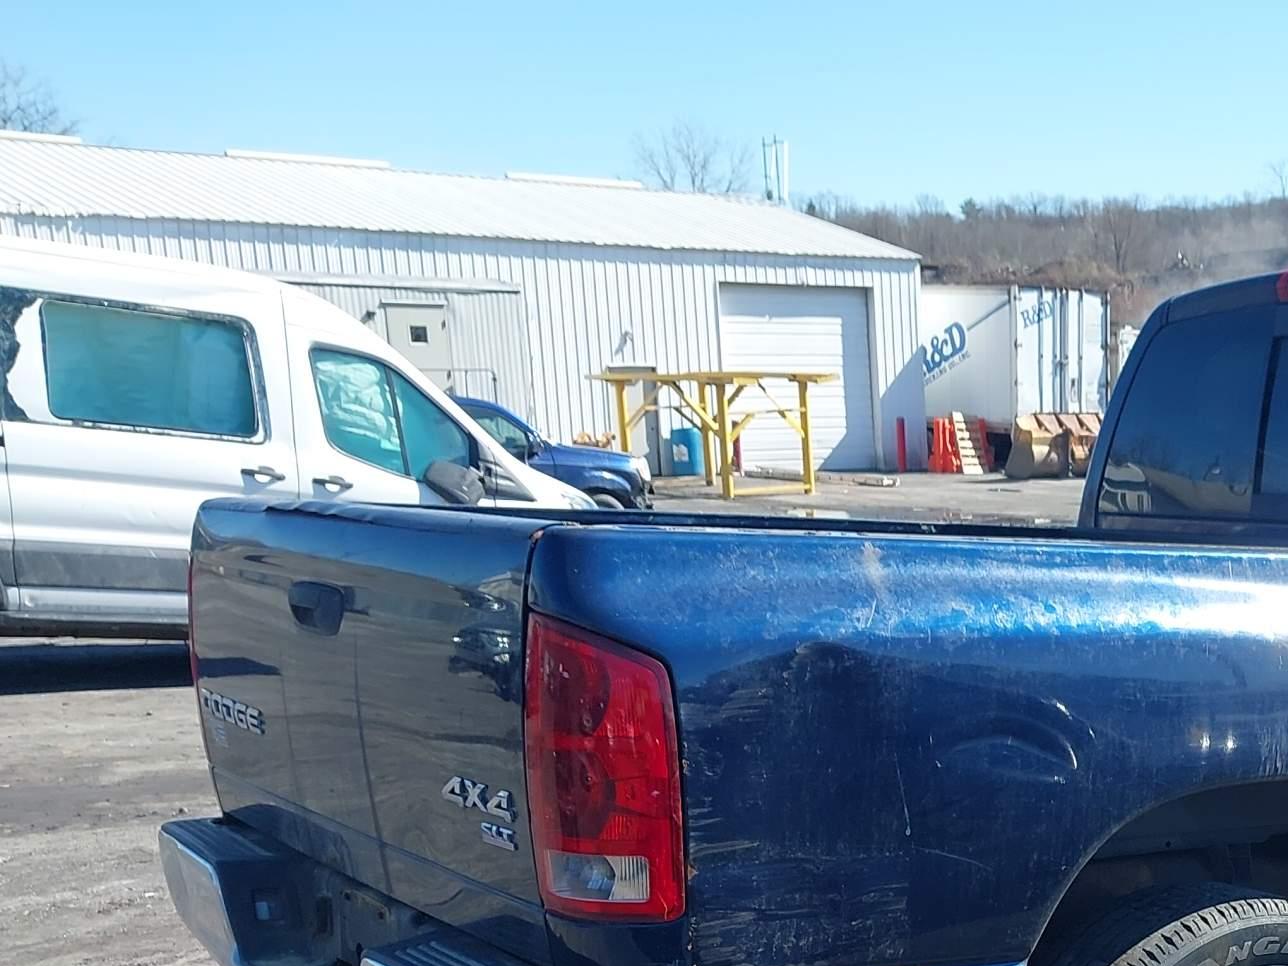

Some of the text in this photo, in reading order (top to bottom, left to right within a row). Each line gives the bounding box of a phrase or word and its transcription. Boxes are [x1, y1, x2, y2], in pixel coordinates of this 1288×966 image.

[1020, 300, 1054, 329] R&D
[201, 688, 262, 735] DODGE
[441, 776, 513, 824] 4X4
[480, 822, 513, 844] SLT
